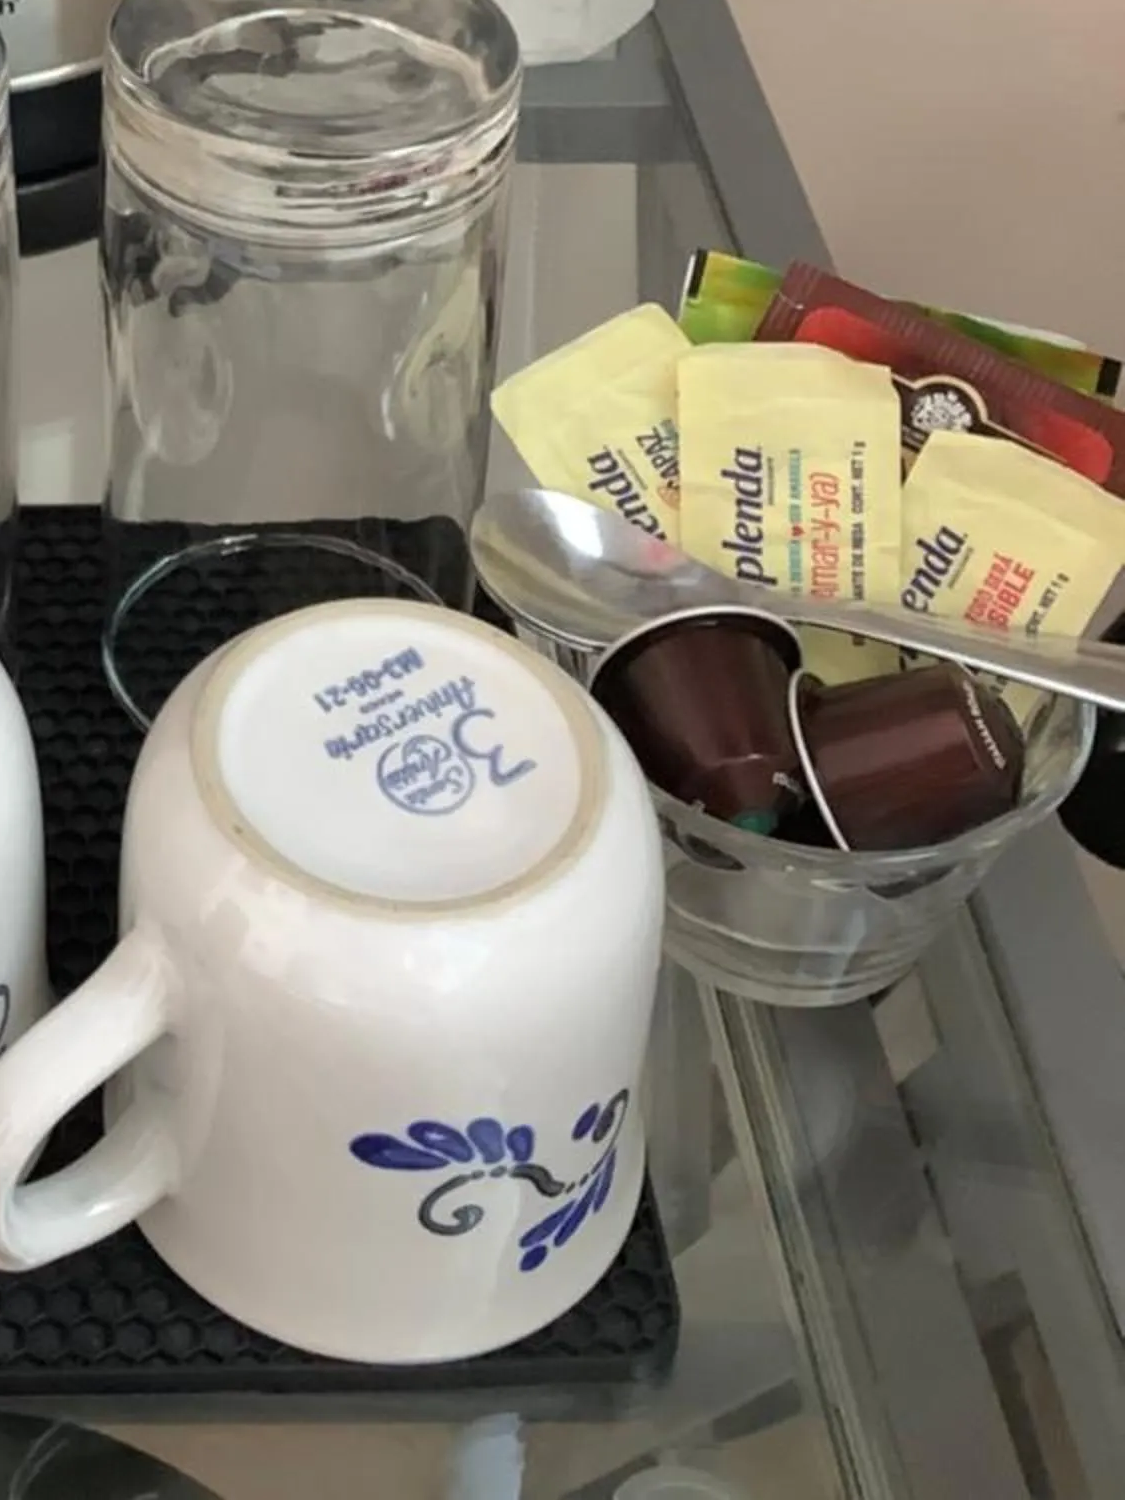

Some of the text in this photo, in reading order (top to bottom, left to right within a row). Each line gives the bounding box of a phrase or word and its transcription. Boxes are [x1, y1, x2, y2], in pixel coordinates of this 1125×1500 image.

[586, 448, 667, 541] enda
[721, 448, 779, 587] plenda
[900, 525, 967, 613] enda
